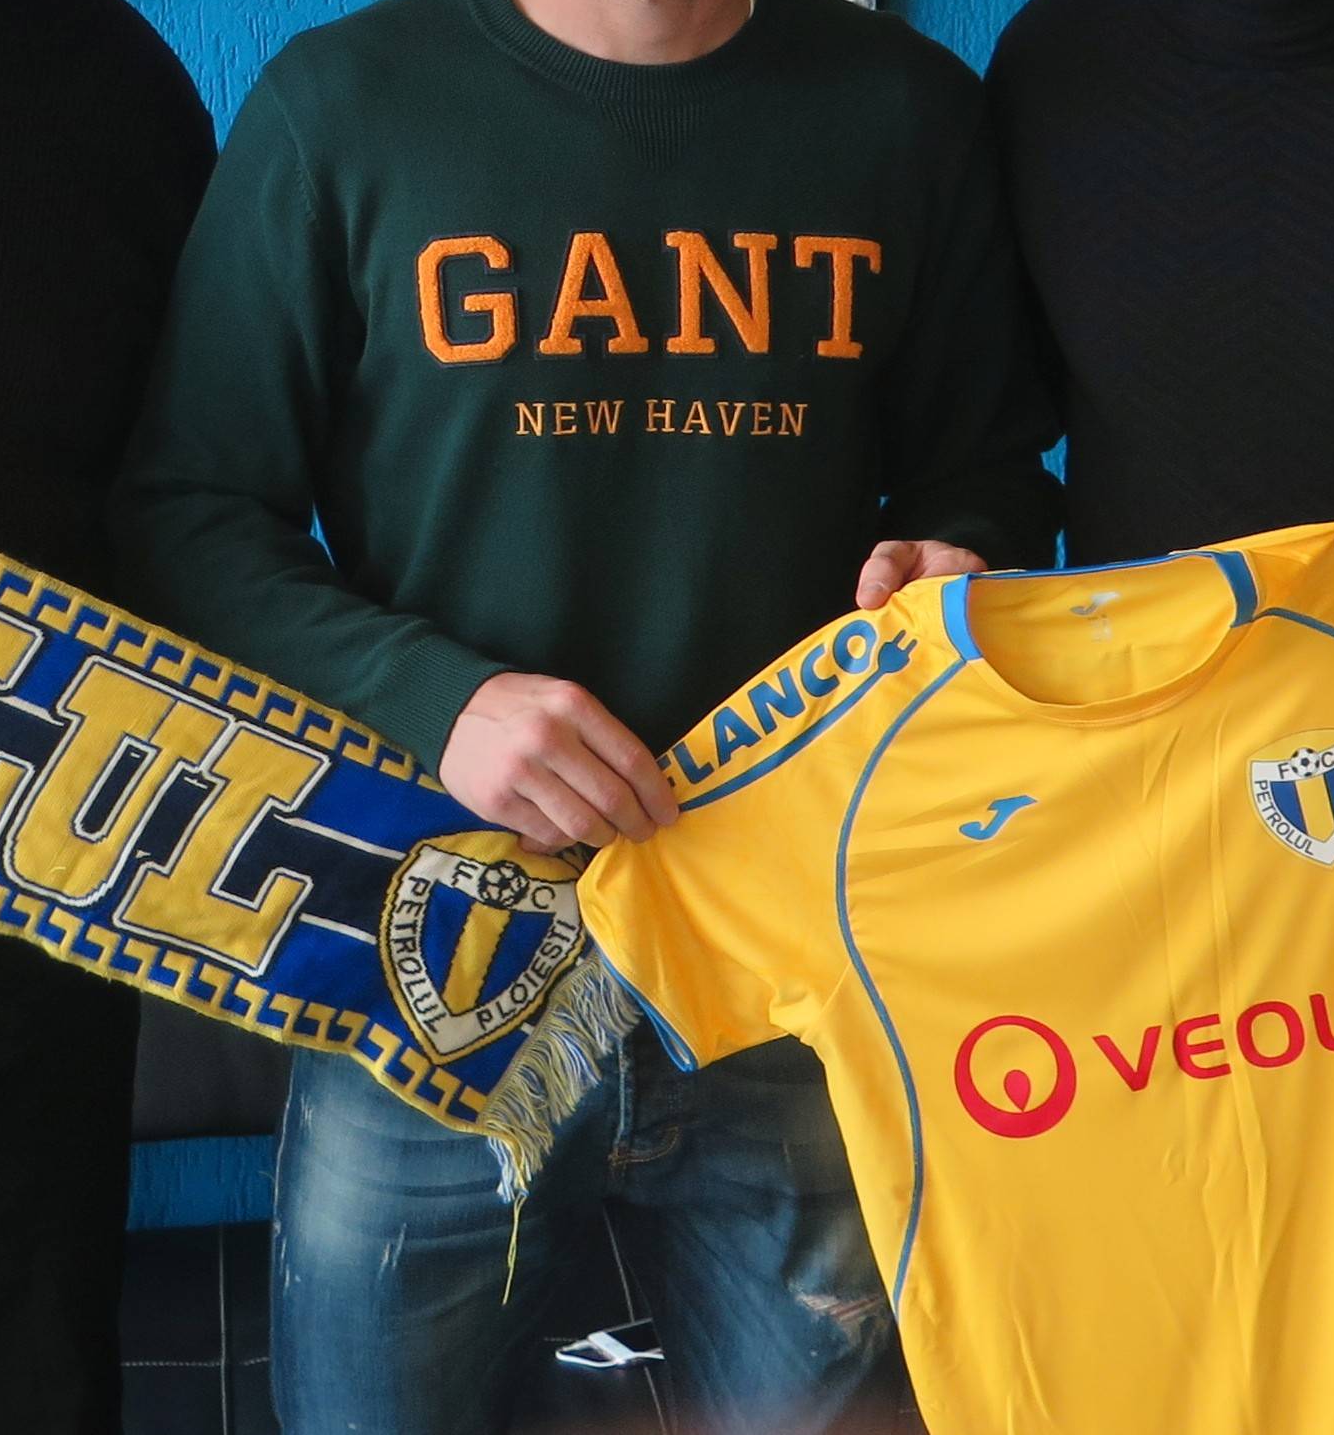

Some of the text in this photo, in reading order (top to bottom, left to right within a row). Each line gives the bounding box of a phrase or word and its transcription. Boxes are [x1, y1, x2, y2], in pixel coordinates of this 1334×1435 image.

[415, 229, 883, 365] GANT
[515, 399, 809, 438] NEW HAVEN
[1253, 779, 1314, 856] PETROLUL
[389, 875, 449, 1034] PETROLUL
[475, 919, 578, 1031] PLOIESTI
